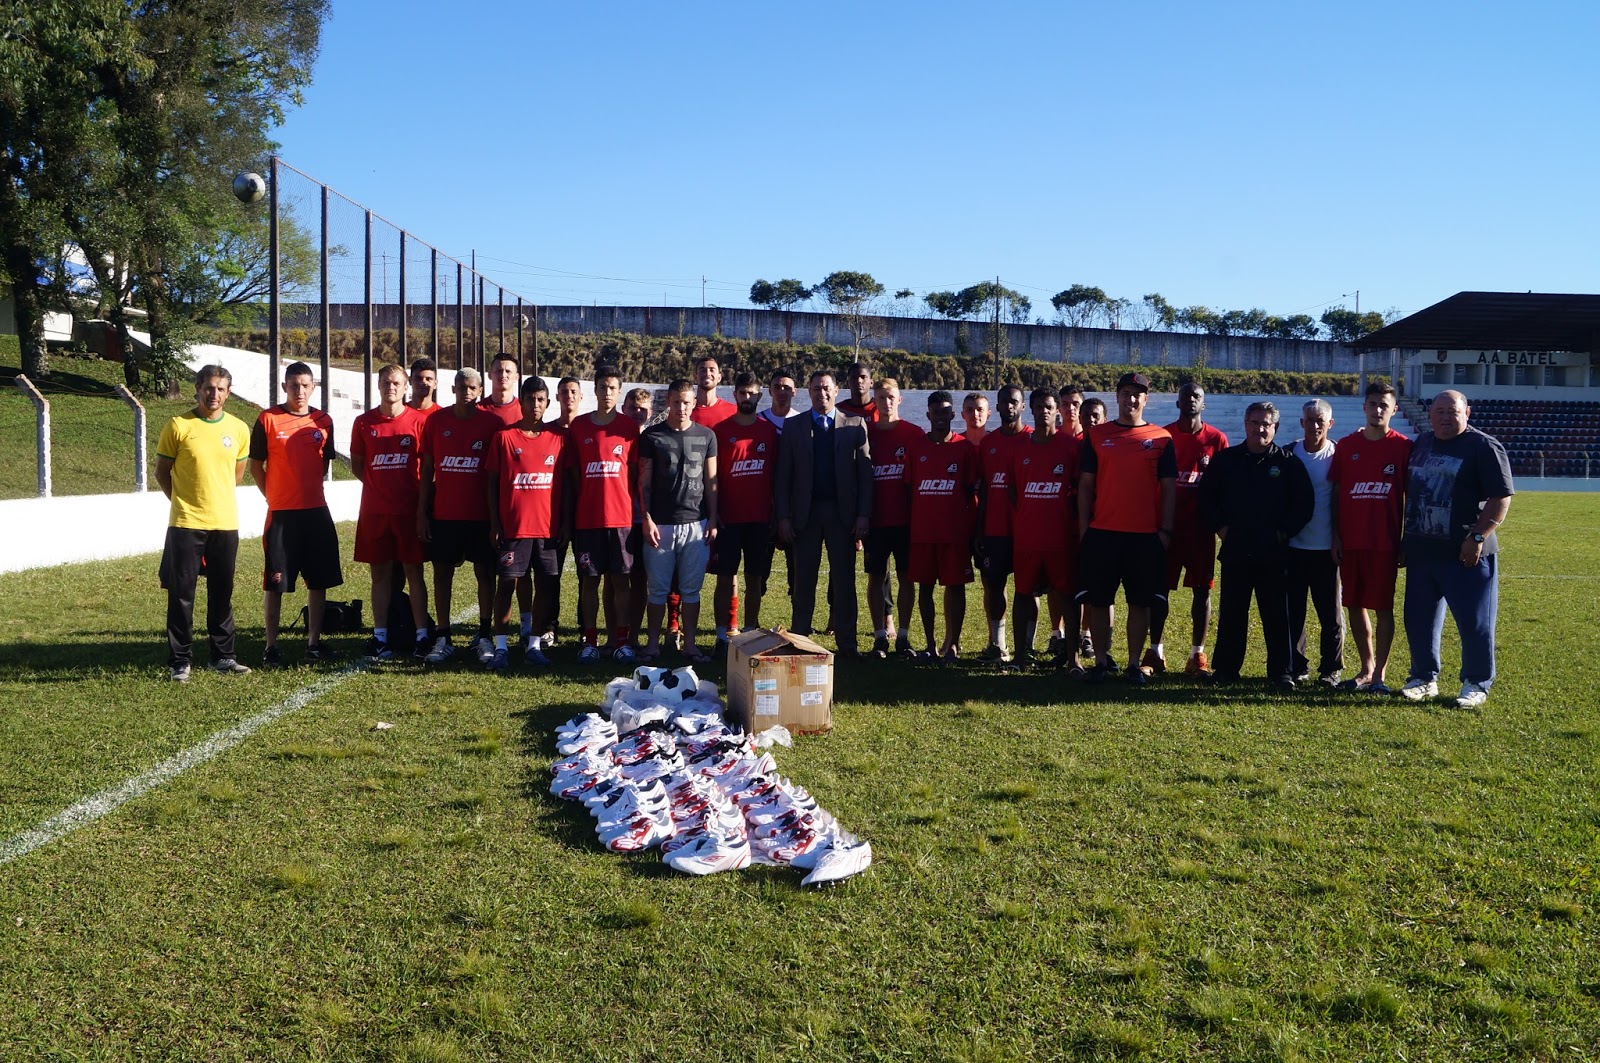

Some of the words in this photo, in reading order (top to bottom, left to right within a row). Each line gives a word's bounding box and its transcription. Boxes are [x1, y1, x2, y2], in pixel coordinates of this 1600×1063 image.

[1507, 352, 1557, 365] BATEL
[371, 453, 409, 466] JOCAR
[440, 456, 480, 468] JOCAR
[585, 461, 621, 473] JOCAR
[730, 459, 765, 473] JOCAR
[871, 464, 905, 476] OCAR
[512, 472, 553, 484] JOCAR
[918, 480, 955, 490] JOCAR
[1024, 482, 1062, 493] JOCAR
[1349, 481, 1392, 494] JOCAR
